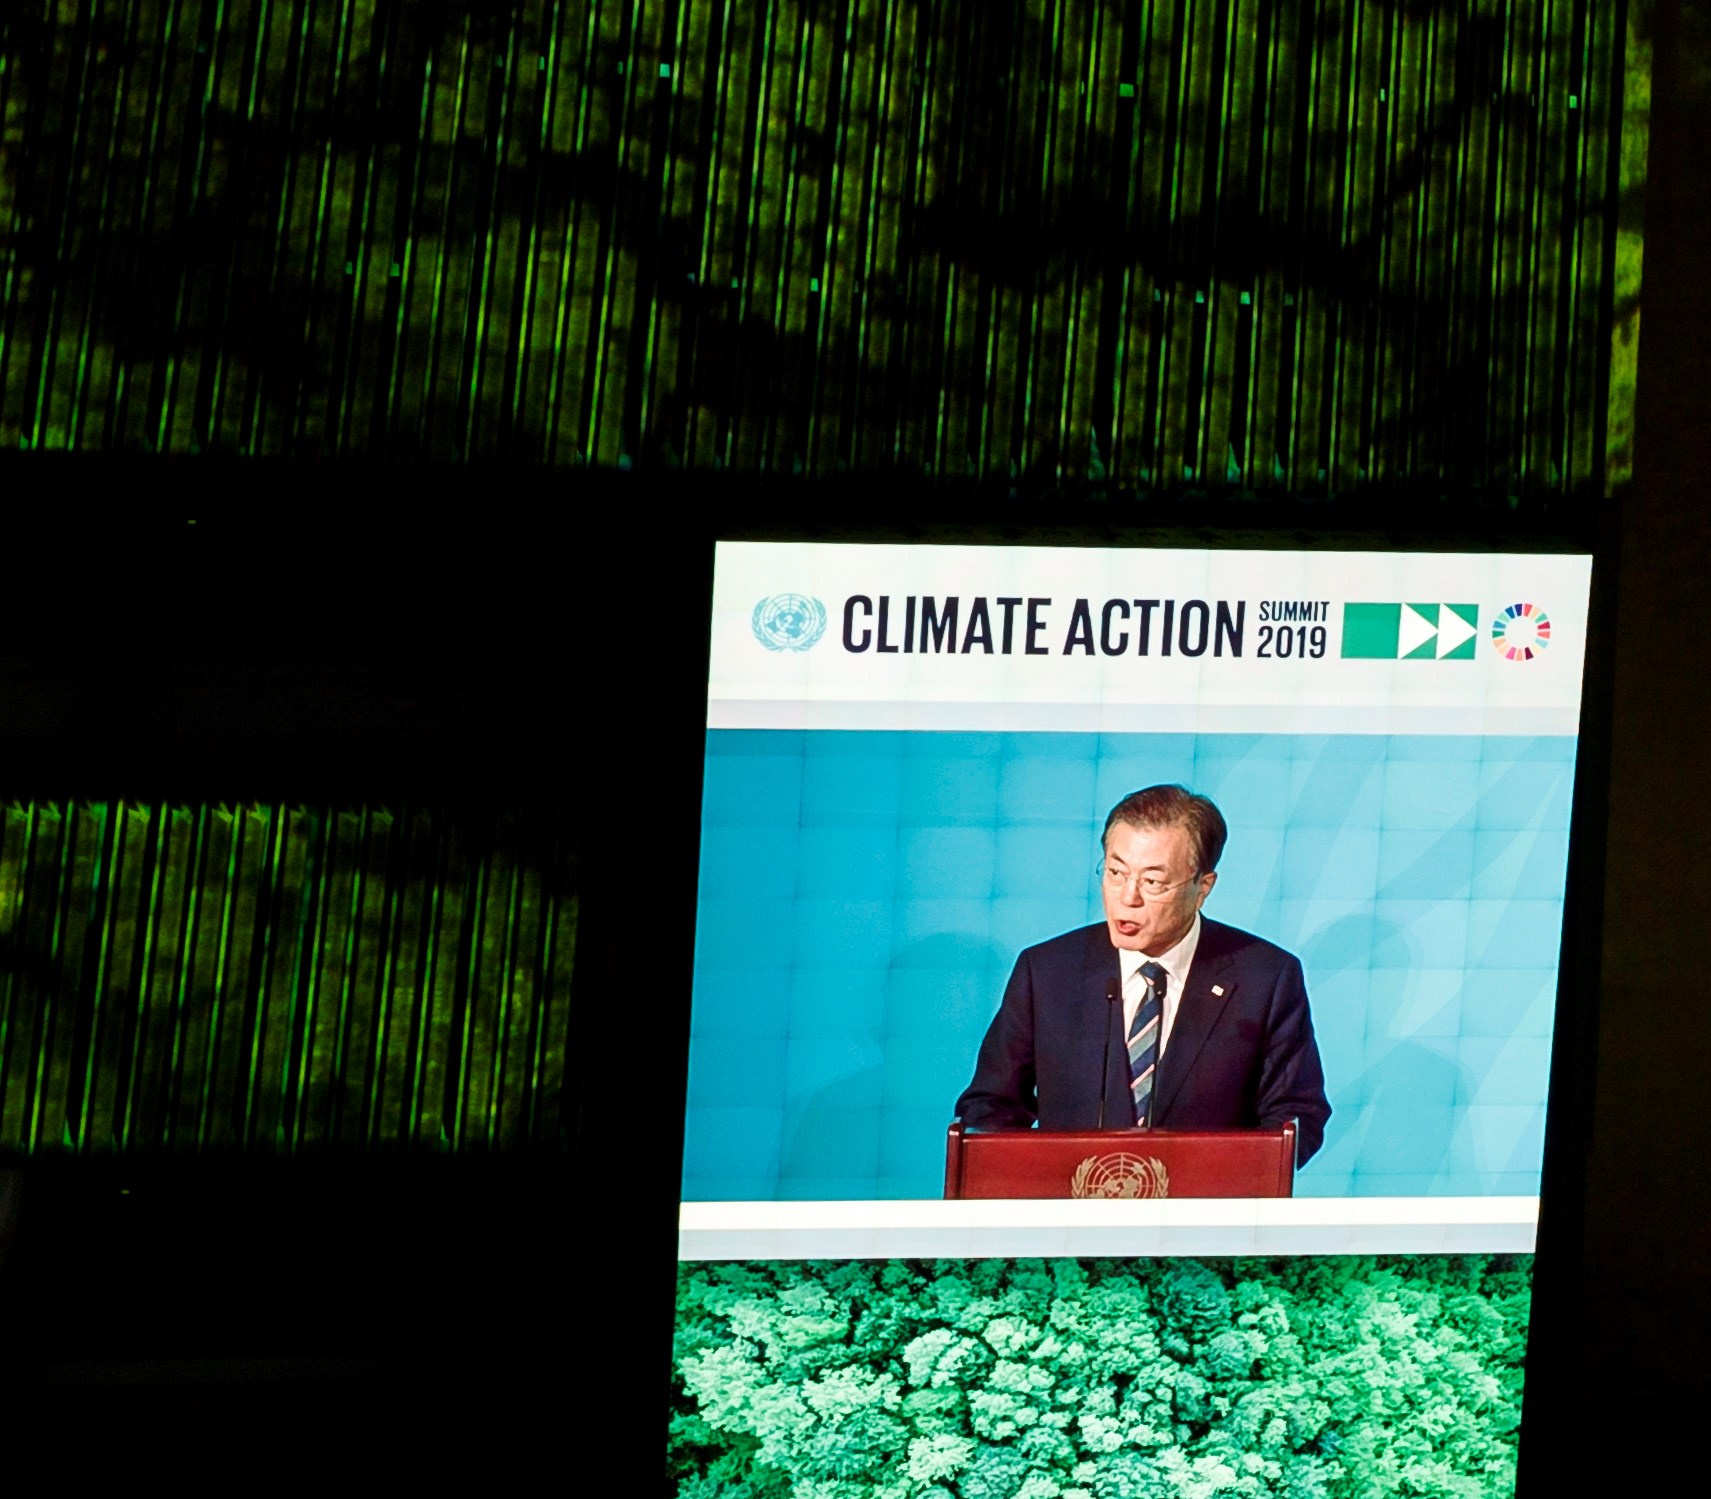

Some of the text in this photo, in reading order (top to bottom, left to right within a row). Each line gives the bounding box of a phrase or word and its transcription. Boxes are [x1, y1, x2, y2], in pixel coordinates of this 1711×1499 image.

[842, 595, 1246, 658] CLIMATE ACTION
[1258, 600, 1330, 622] SUMMIT
[1256, 626, 1327, 659] 2019
